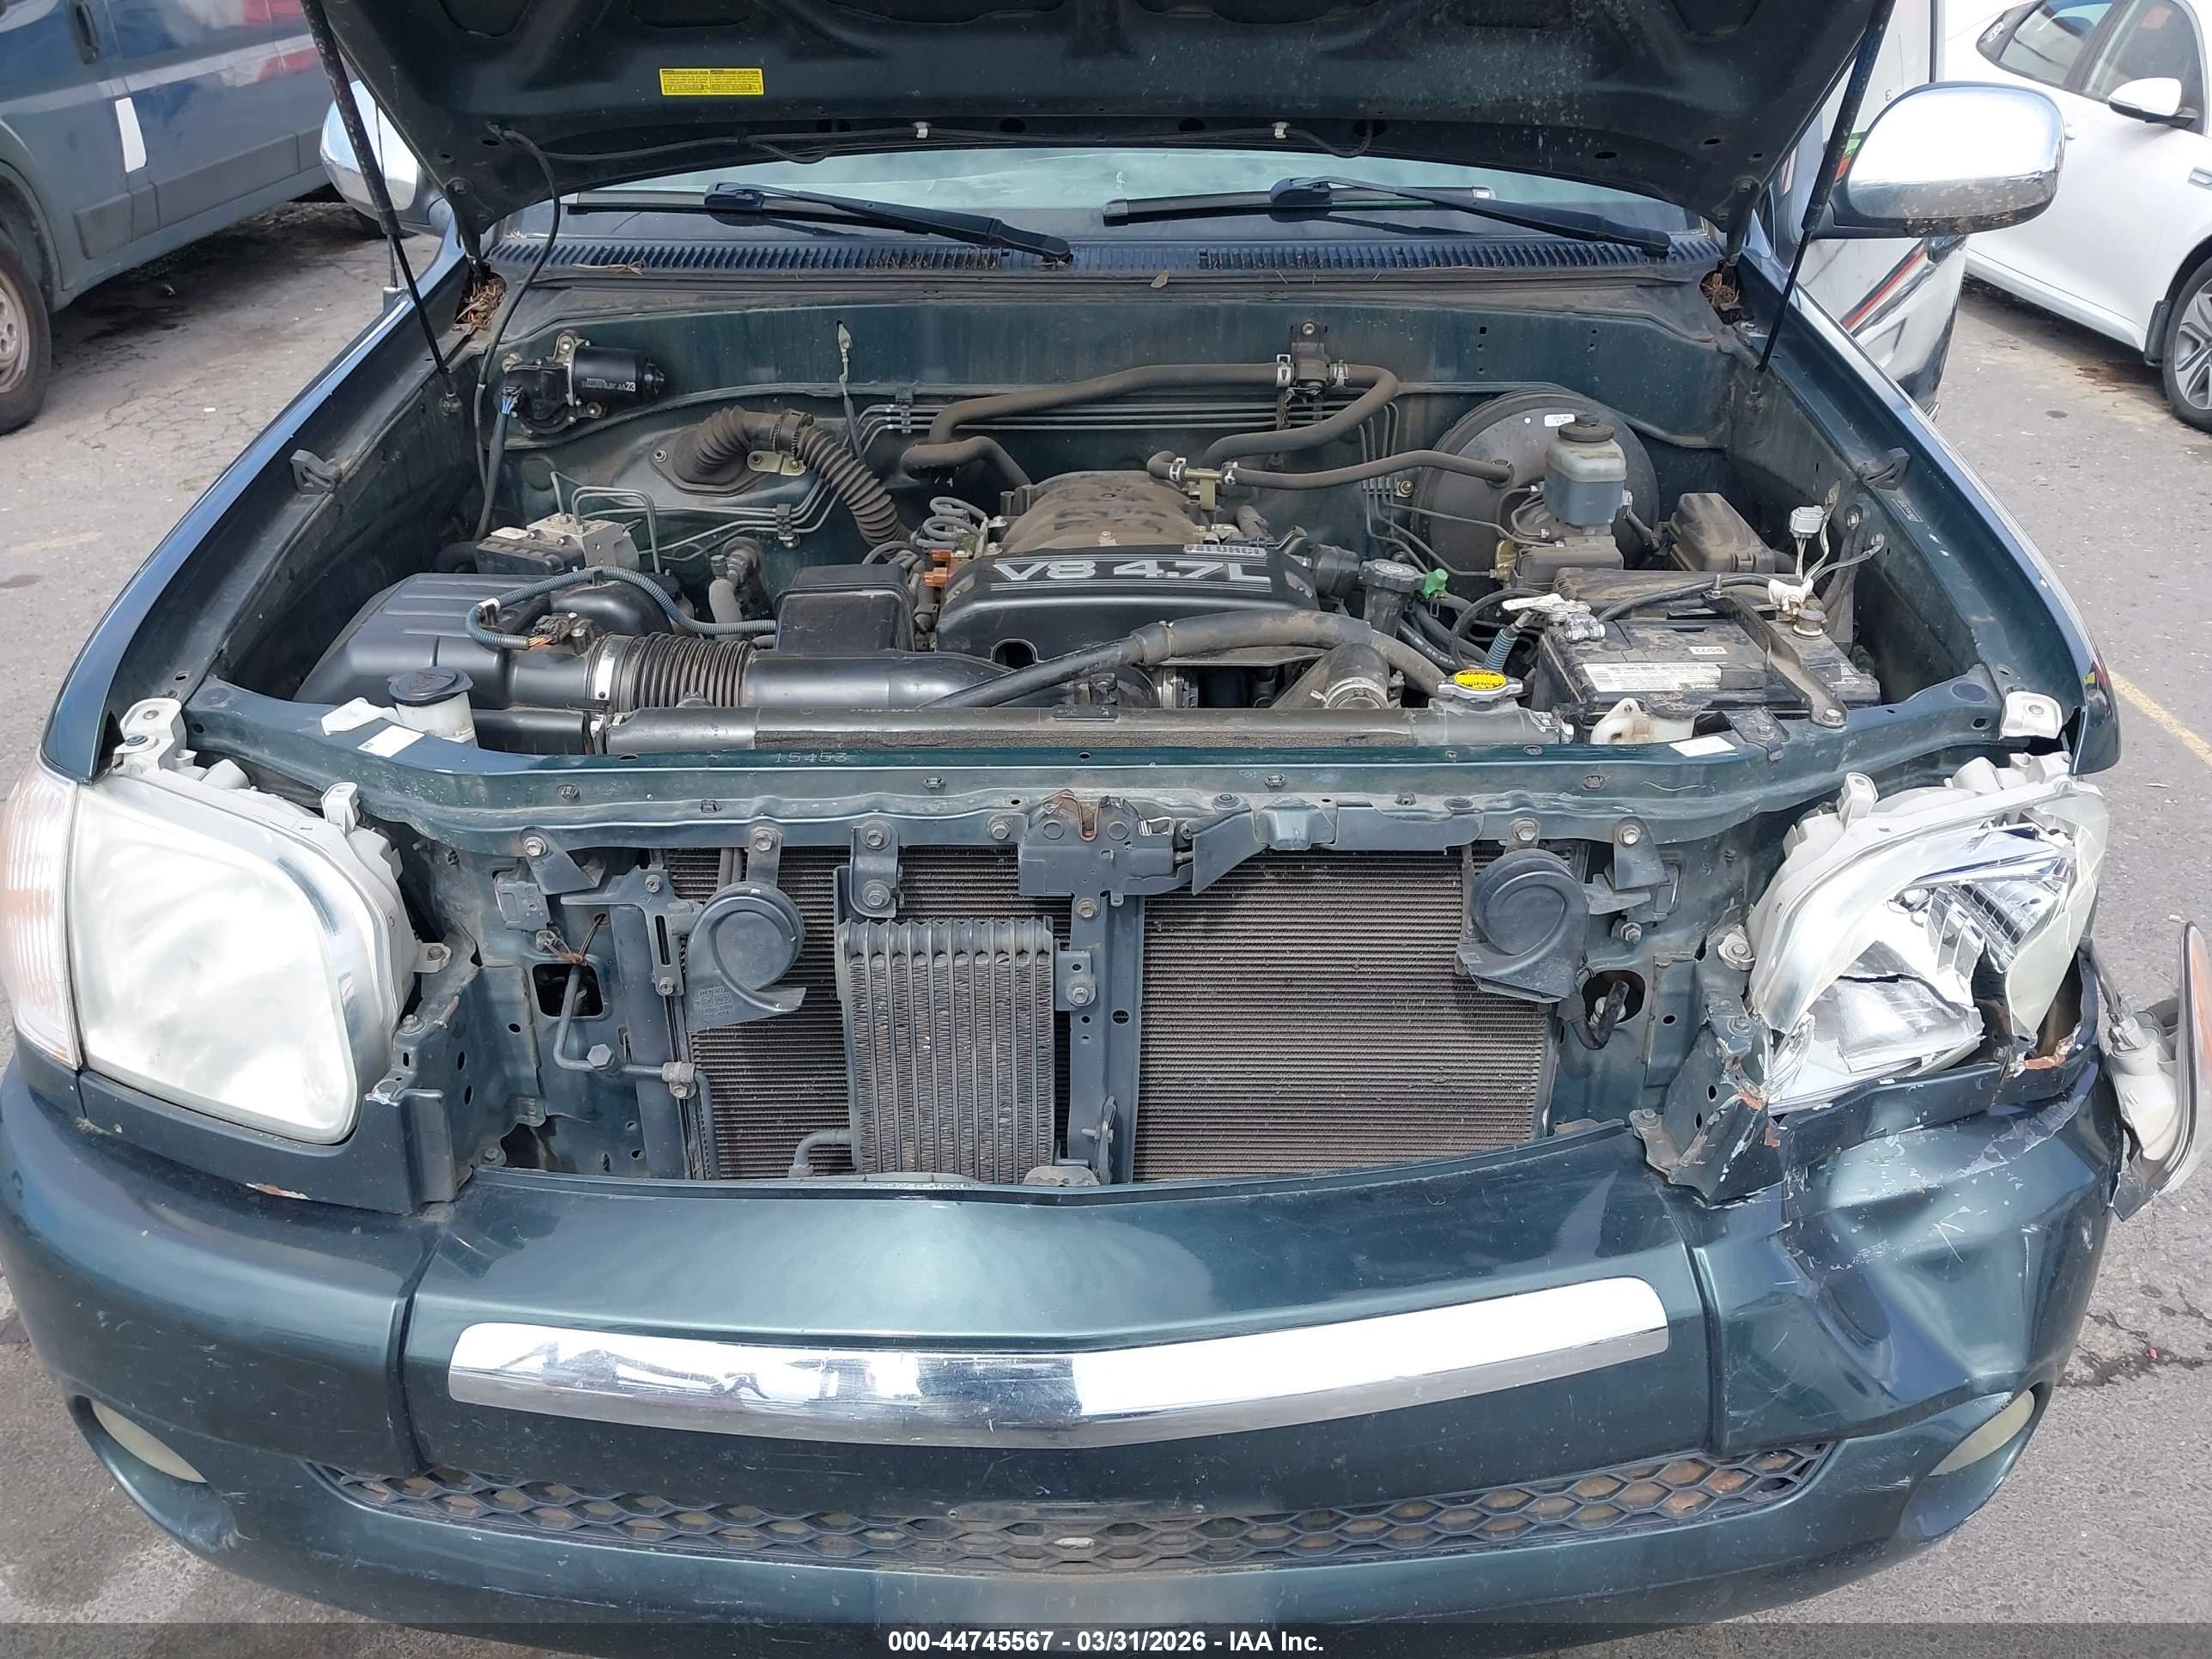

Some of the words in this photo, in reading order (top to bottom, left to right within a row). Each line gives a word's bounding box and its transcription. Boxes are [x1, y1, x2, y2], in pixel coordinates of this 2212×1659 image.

[992, 560, 1097, 581] V8
[1113, 560, 1272, 583] 4.7L
[774, 751, 848, 763] 15453
